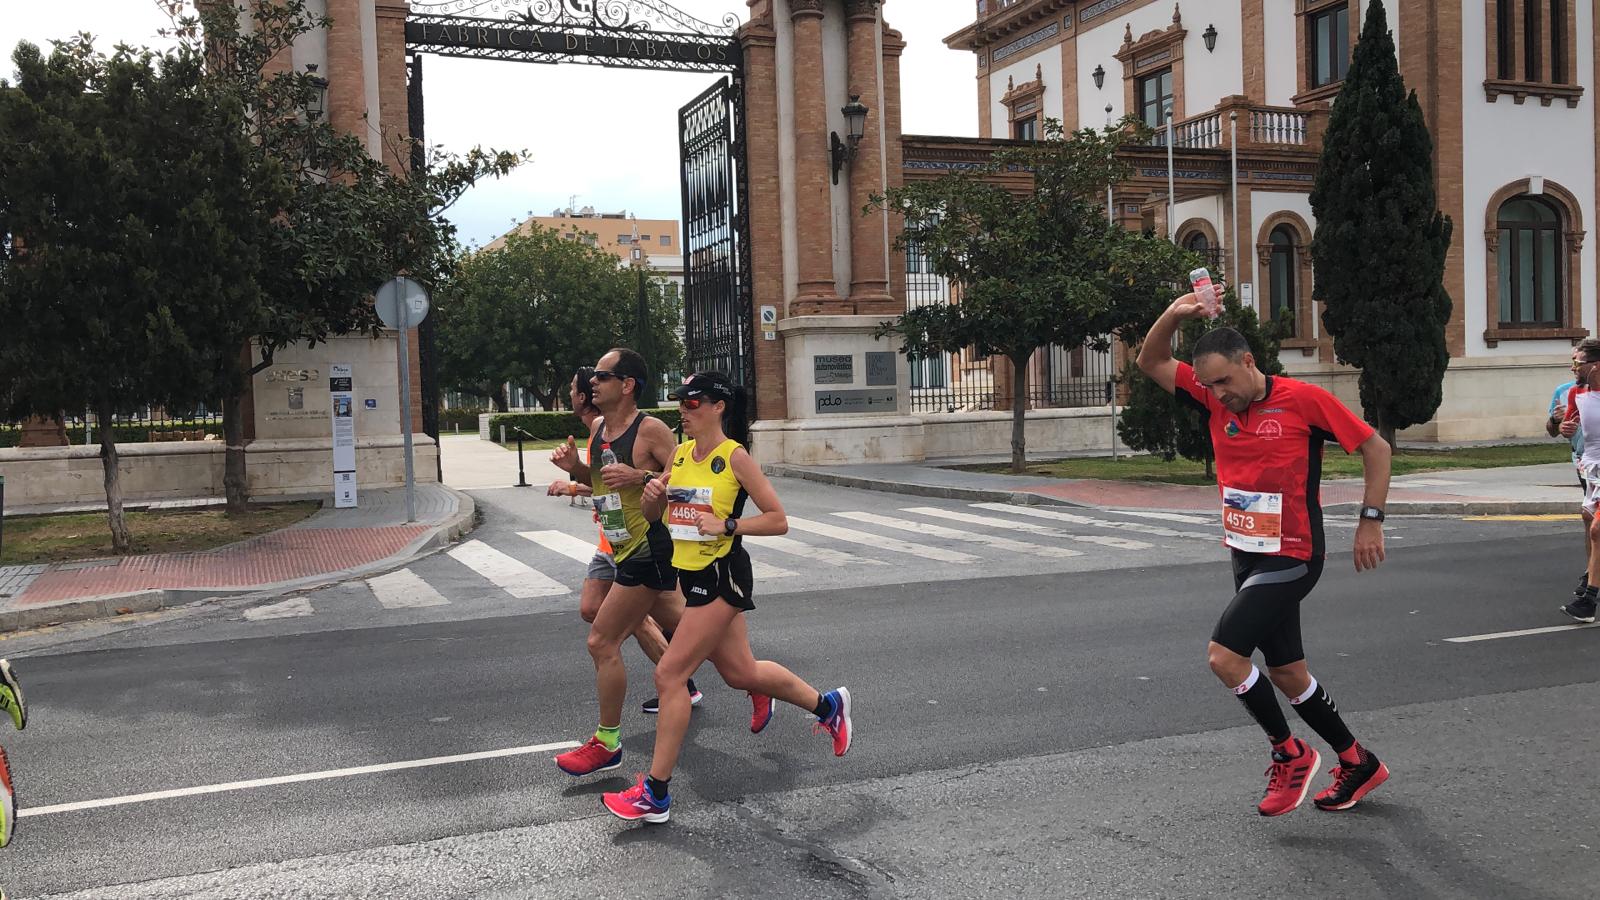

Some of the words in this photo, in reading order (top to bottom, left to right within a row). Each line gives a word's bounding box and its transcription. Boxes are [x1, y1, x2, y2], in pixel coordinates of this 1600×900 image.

[421, 23, 543, 47] FABRICA
[566, 34, 594, 51] DE
[614, 38, 726, 60] TABACOS
[671, 506, 697, 519] 4468
[1226, 511, 1255, 529] 4573
